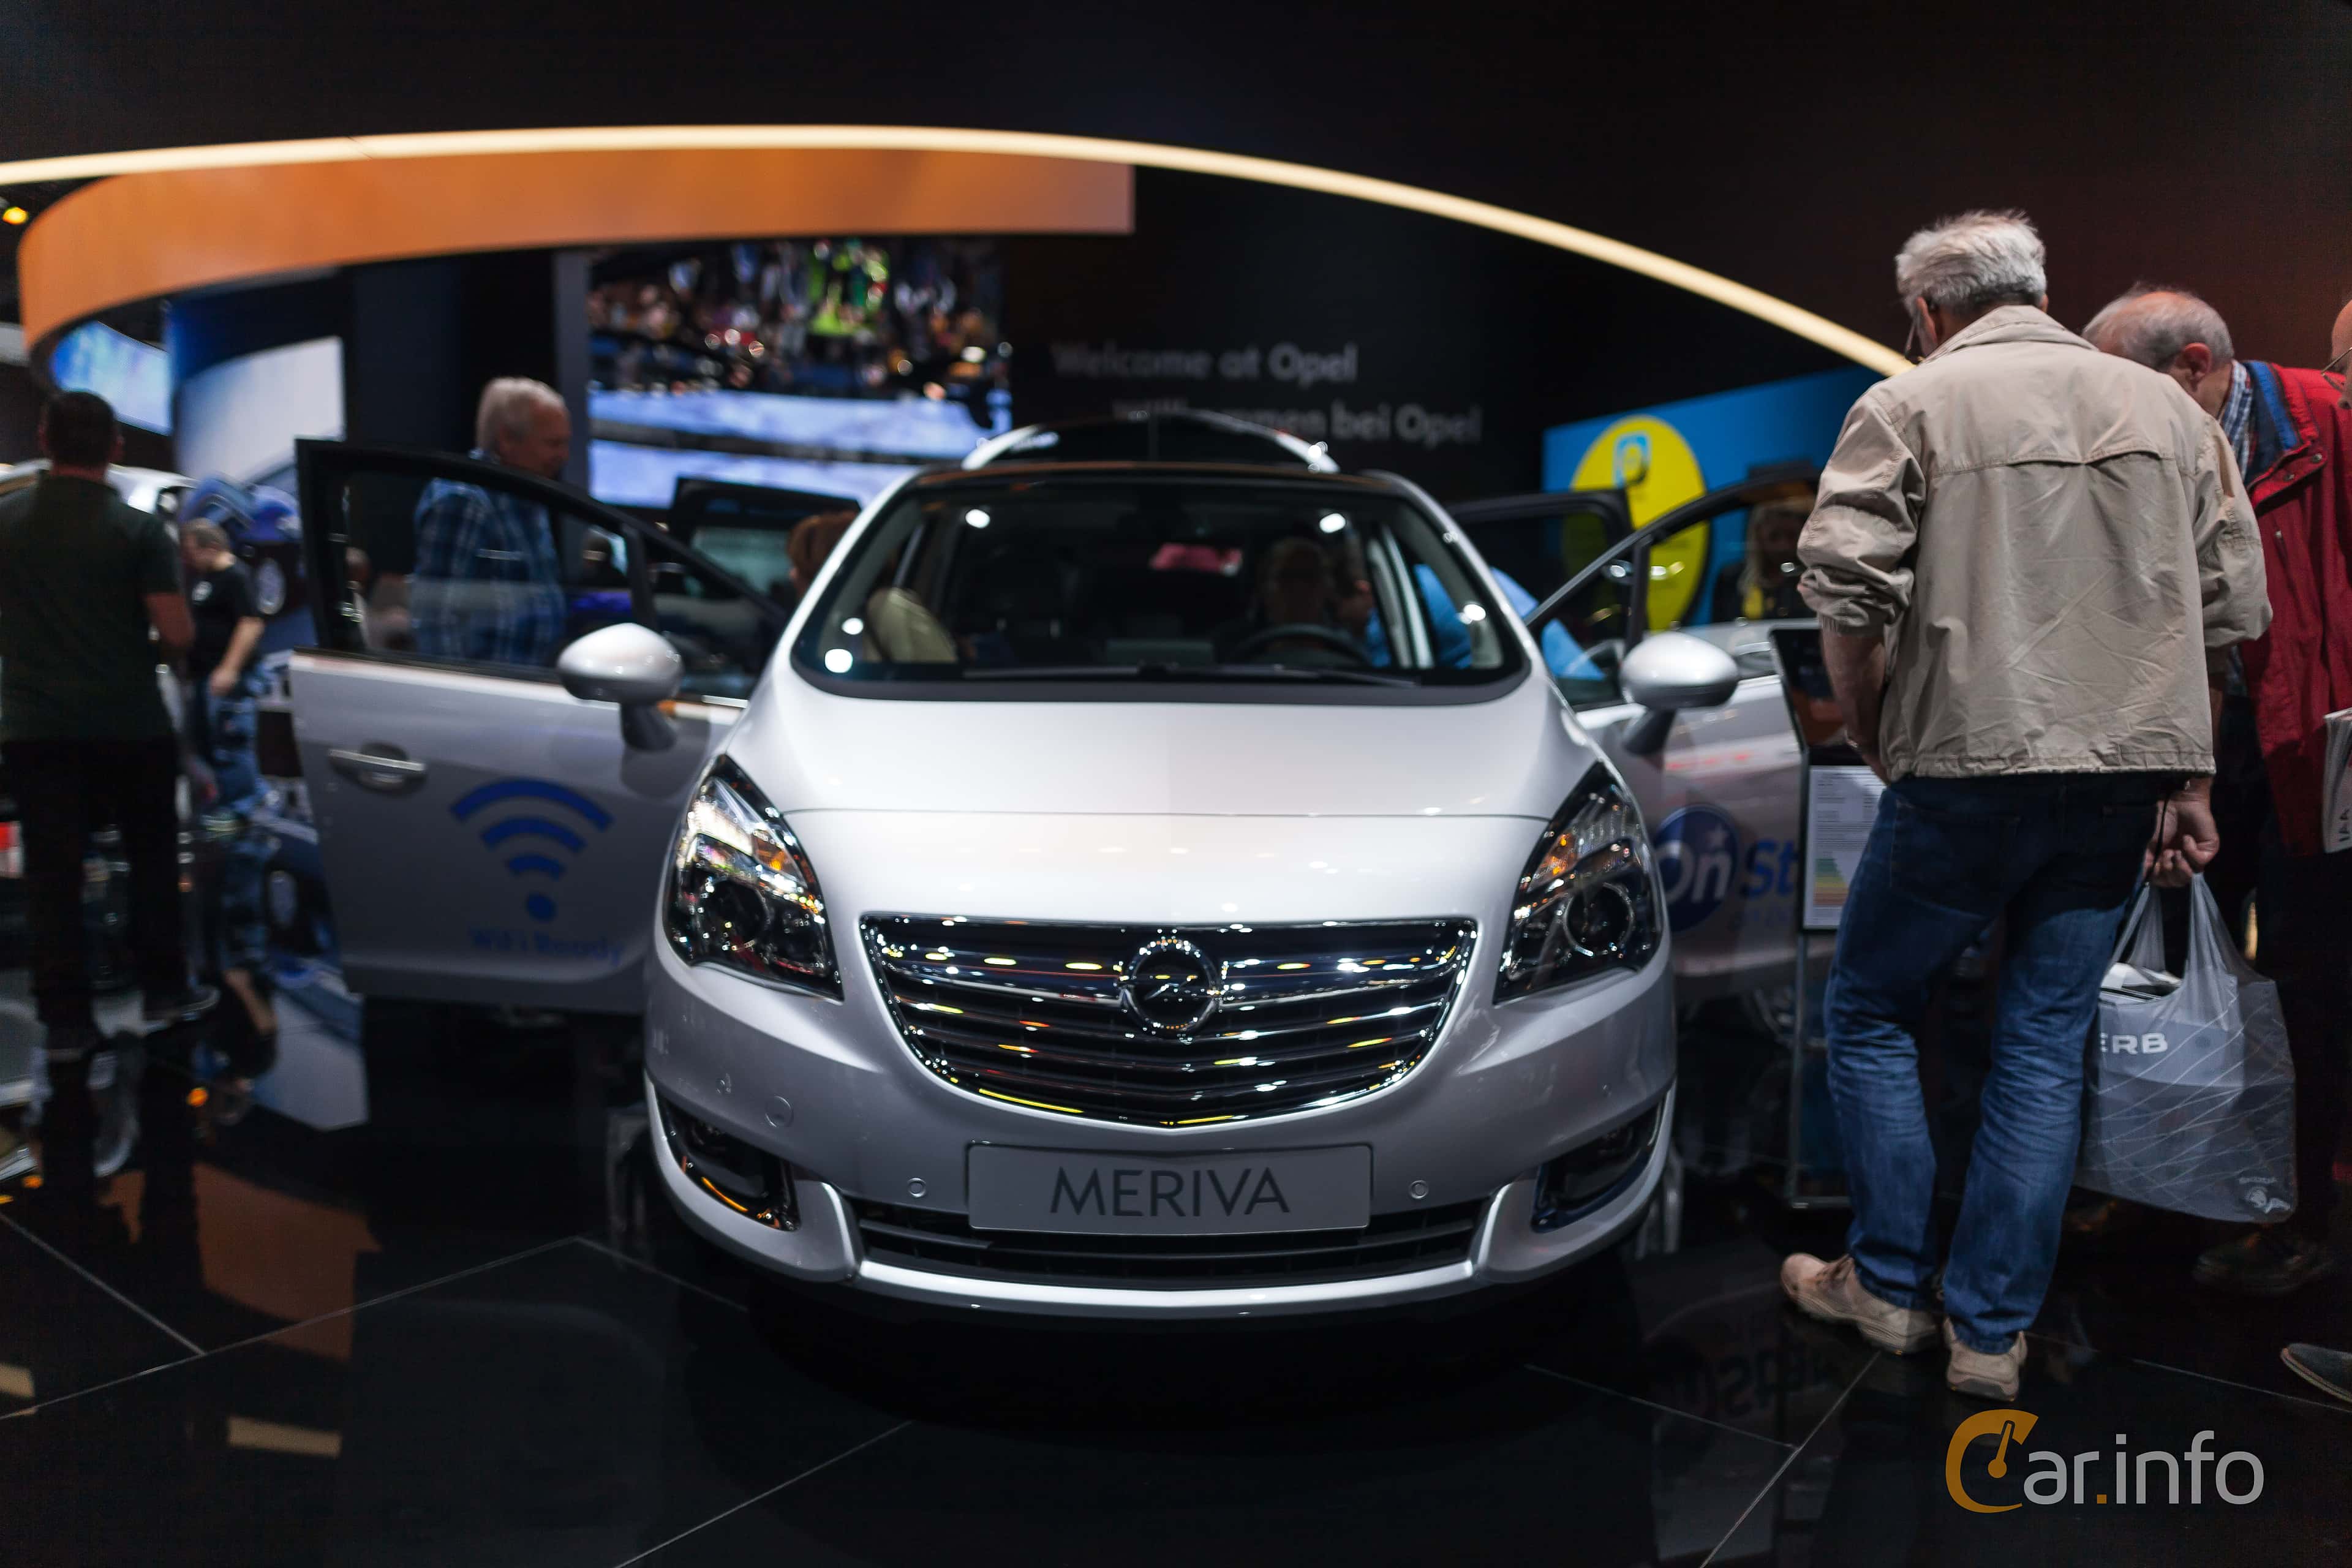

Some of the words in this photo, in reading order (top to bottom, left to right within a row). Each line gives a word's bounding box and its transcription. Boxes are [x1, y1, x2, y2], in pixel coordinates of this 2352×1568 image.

[1049, 341, 1212, 379] Welcome
[1219, 345, 1262, 380] at
[1268, 341, 1359, 388] Opel
[1330, 398, 1391, 441] bei
[1395, 402, 1483, 448] Opel
[1050, 1166, 1291, 1218] MERIVA
